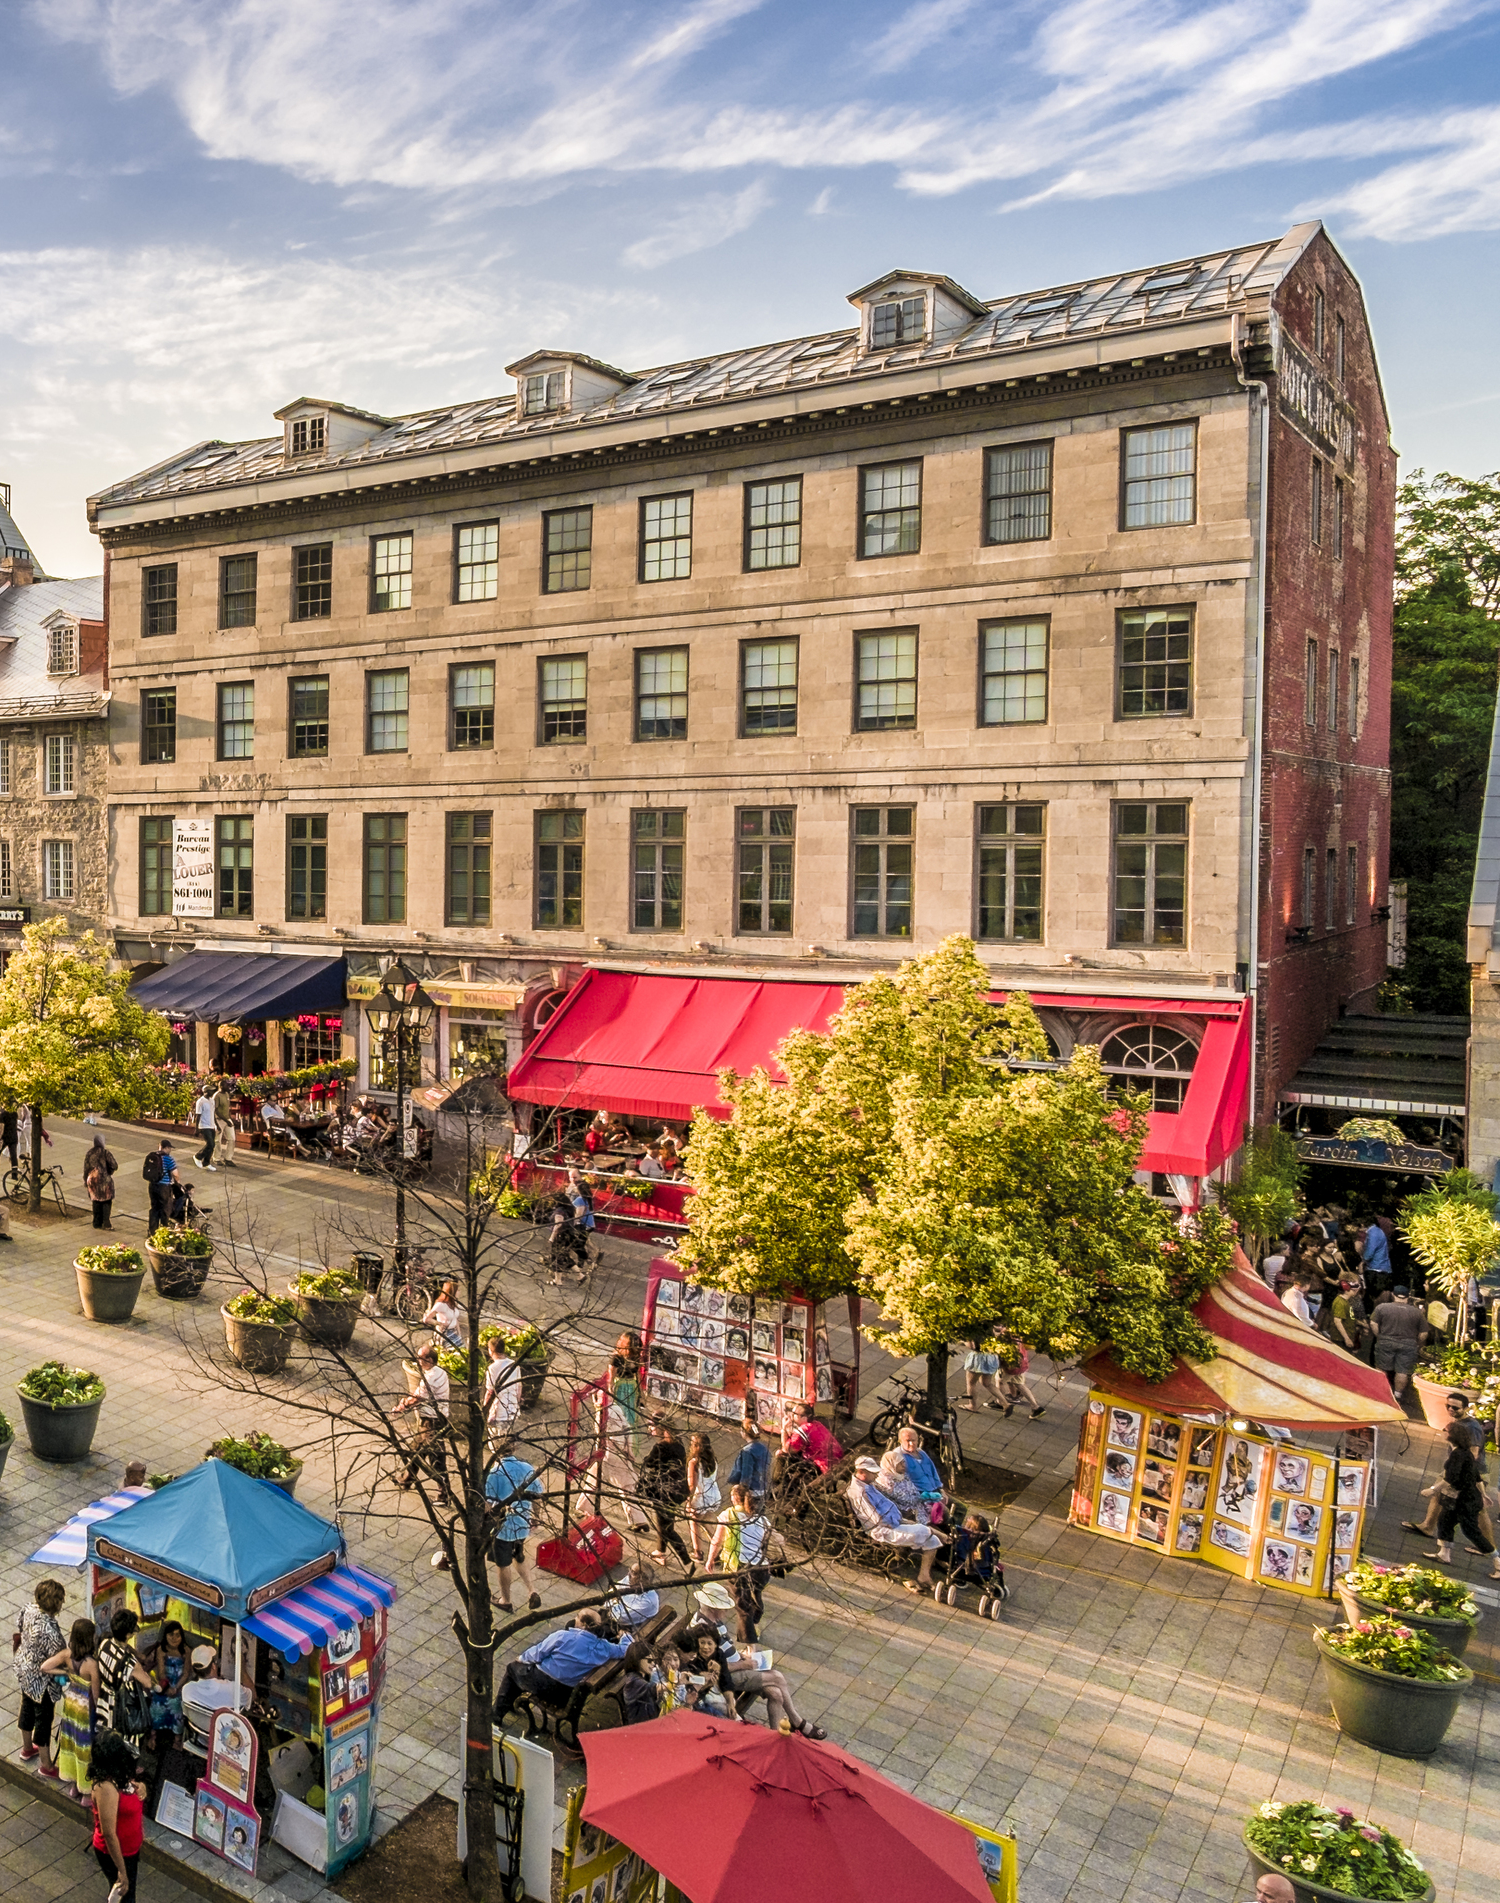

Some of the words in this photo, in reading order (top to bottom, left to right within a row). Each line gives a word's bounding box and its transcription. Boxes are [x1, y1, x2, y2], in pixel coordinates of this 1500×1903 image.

[177, 834, 210, 843] Bureau
[175, 844, 211, 855] Prestige
[173, 862, 214, 880] LOUER
[173, 888, 213, 899] 861-1001
[463, 992, 511, 1006] SOUVENIRS
[1298, 1141, 1359, 1161] Jardin
[1384, 1147, 1443, 1169] Nelson
